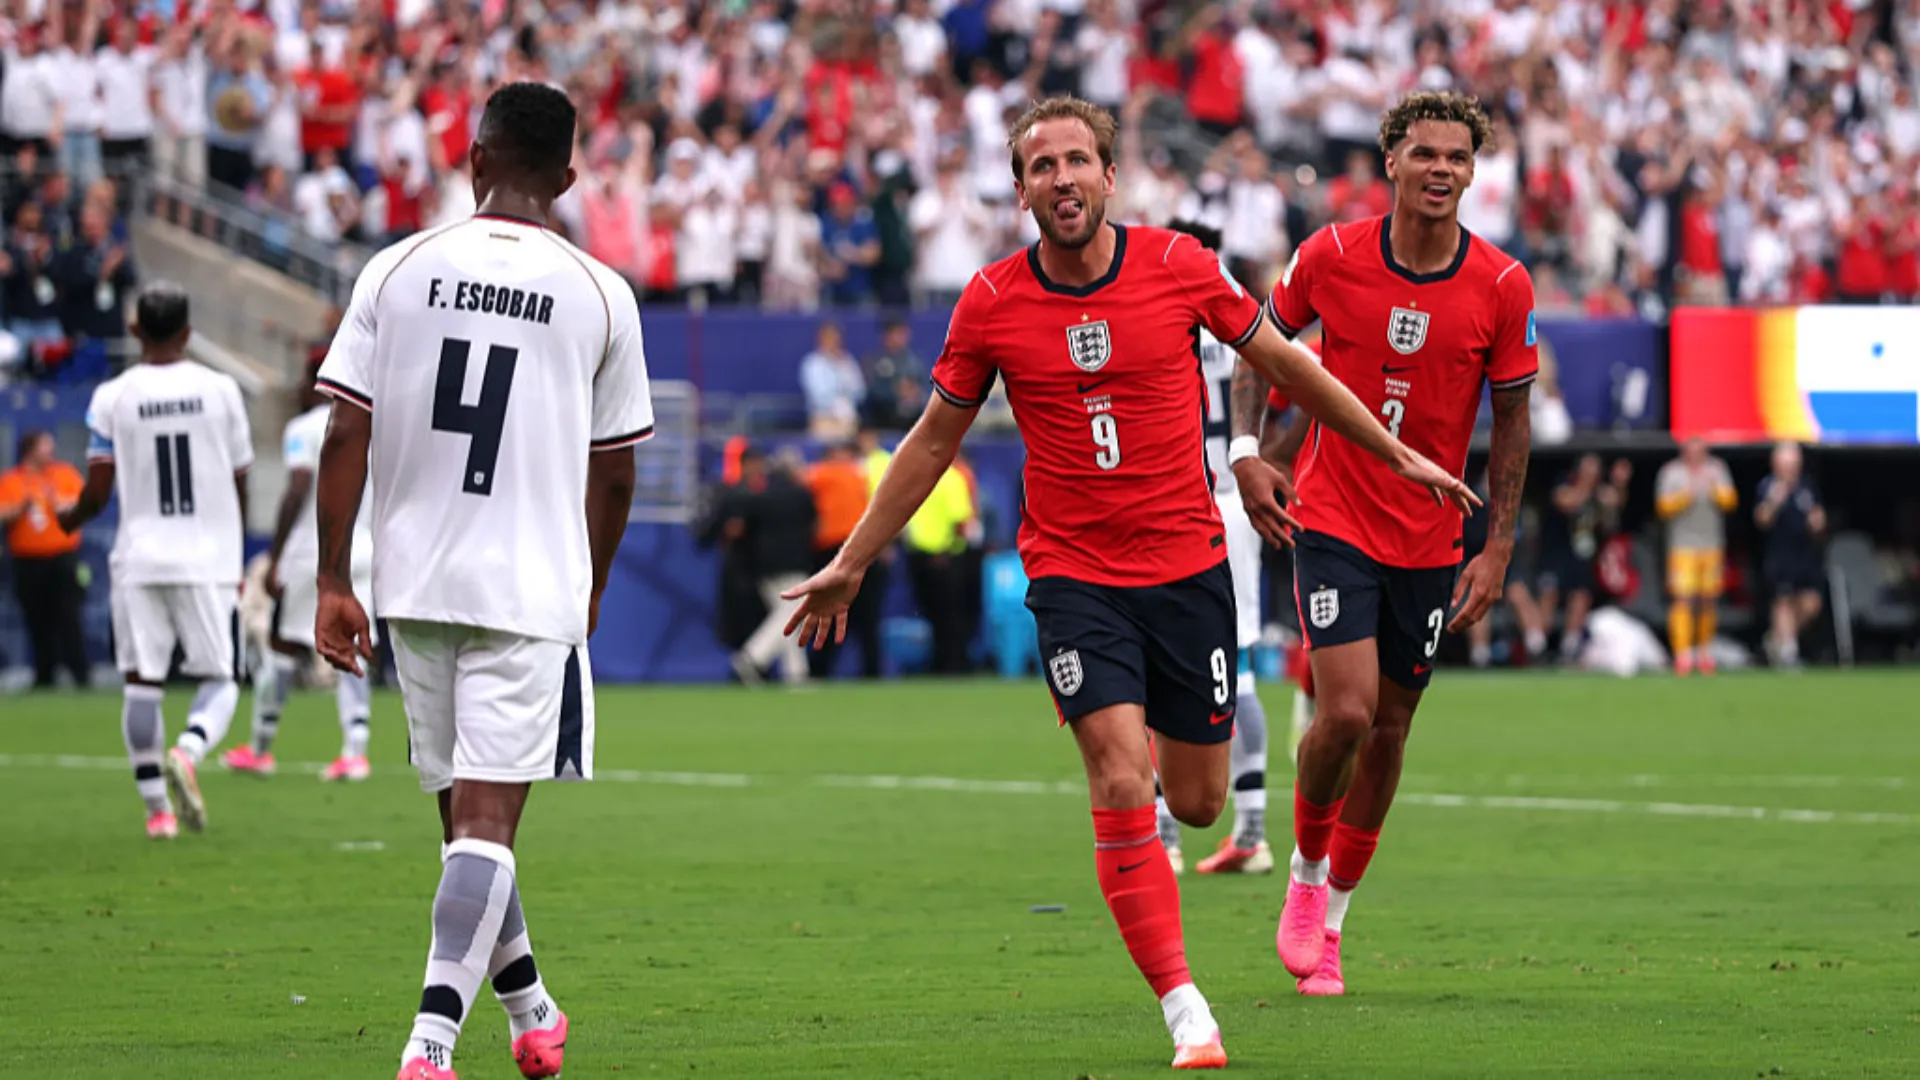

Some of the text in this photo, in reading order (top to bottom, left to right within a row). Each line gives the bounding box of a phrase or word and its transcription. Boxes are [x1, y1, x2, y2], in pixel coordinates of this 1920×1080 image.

[427, 277, 555, 326] F. ESCOBAR
[431, 336, 520, 497] 4
[1090, 412, 1121, 471] 9
[1381, 398, 1405, 440] 3
[154, 432, 195, 516] 11
[1424, 607, 1444, 658] 3
[1210, 646, 1229, 706] 9
